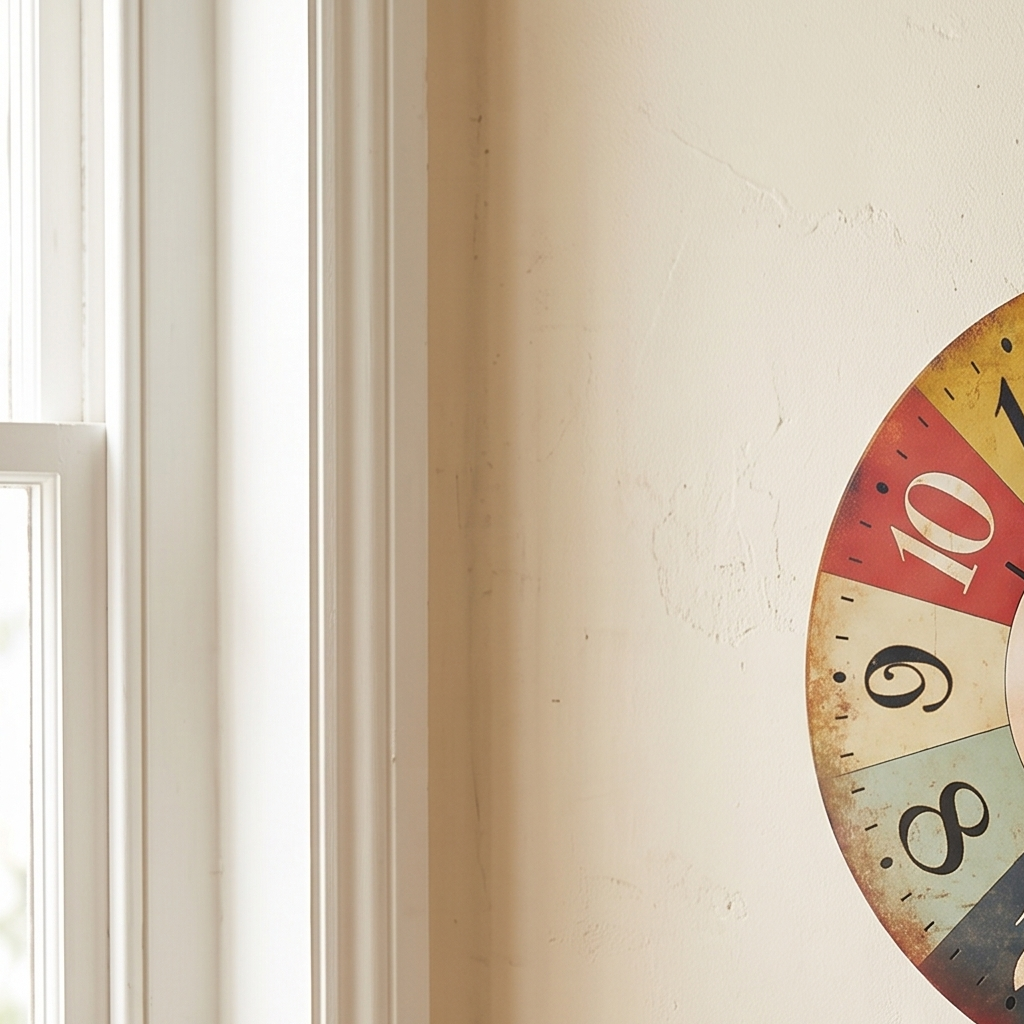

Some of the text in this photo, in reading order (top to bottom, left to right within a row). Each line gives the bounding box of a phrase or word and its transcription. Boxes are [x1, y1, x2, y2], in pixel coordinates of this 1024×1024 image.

[890, 471, 996, 595] 10
[864, 644, 953, 713] 9
[898, 781, 990, 875] 8
